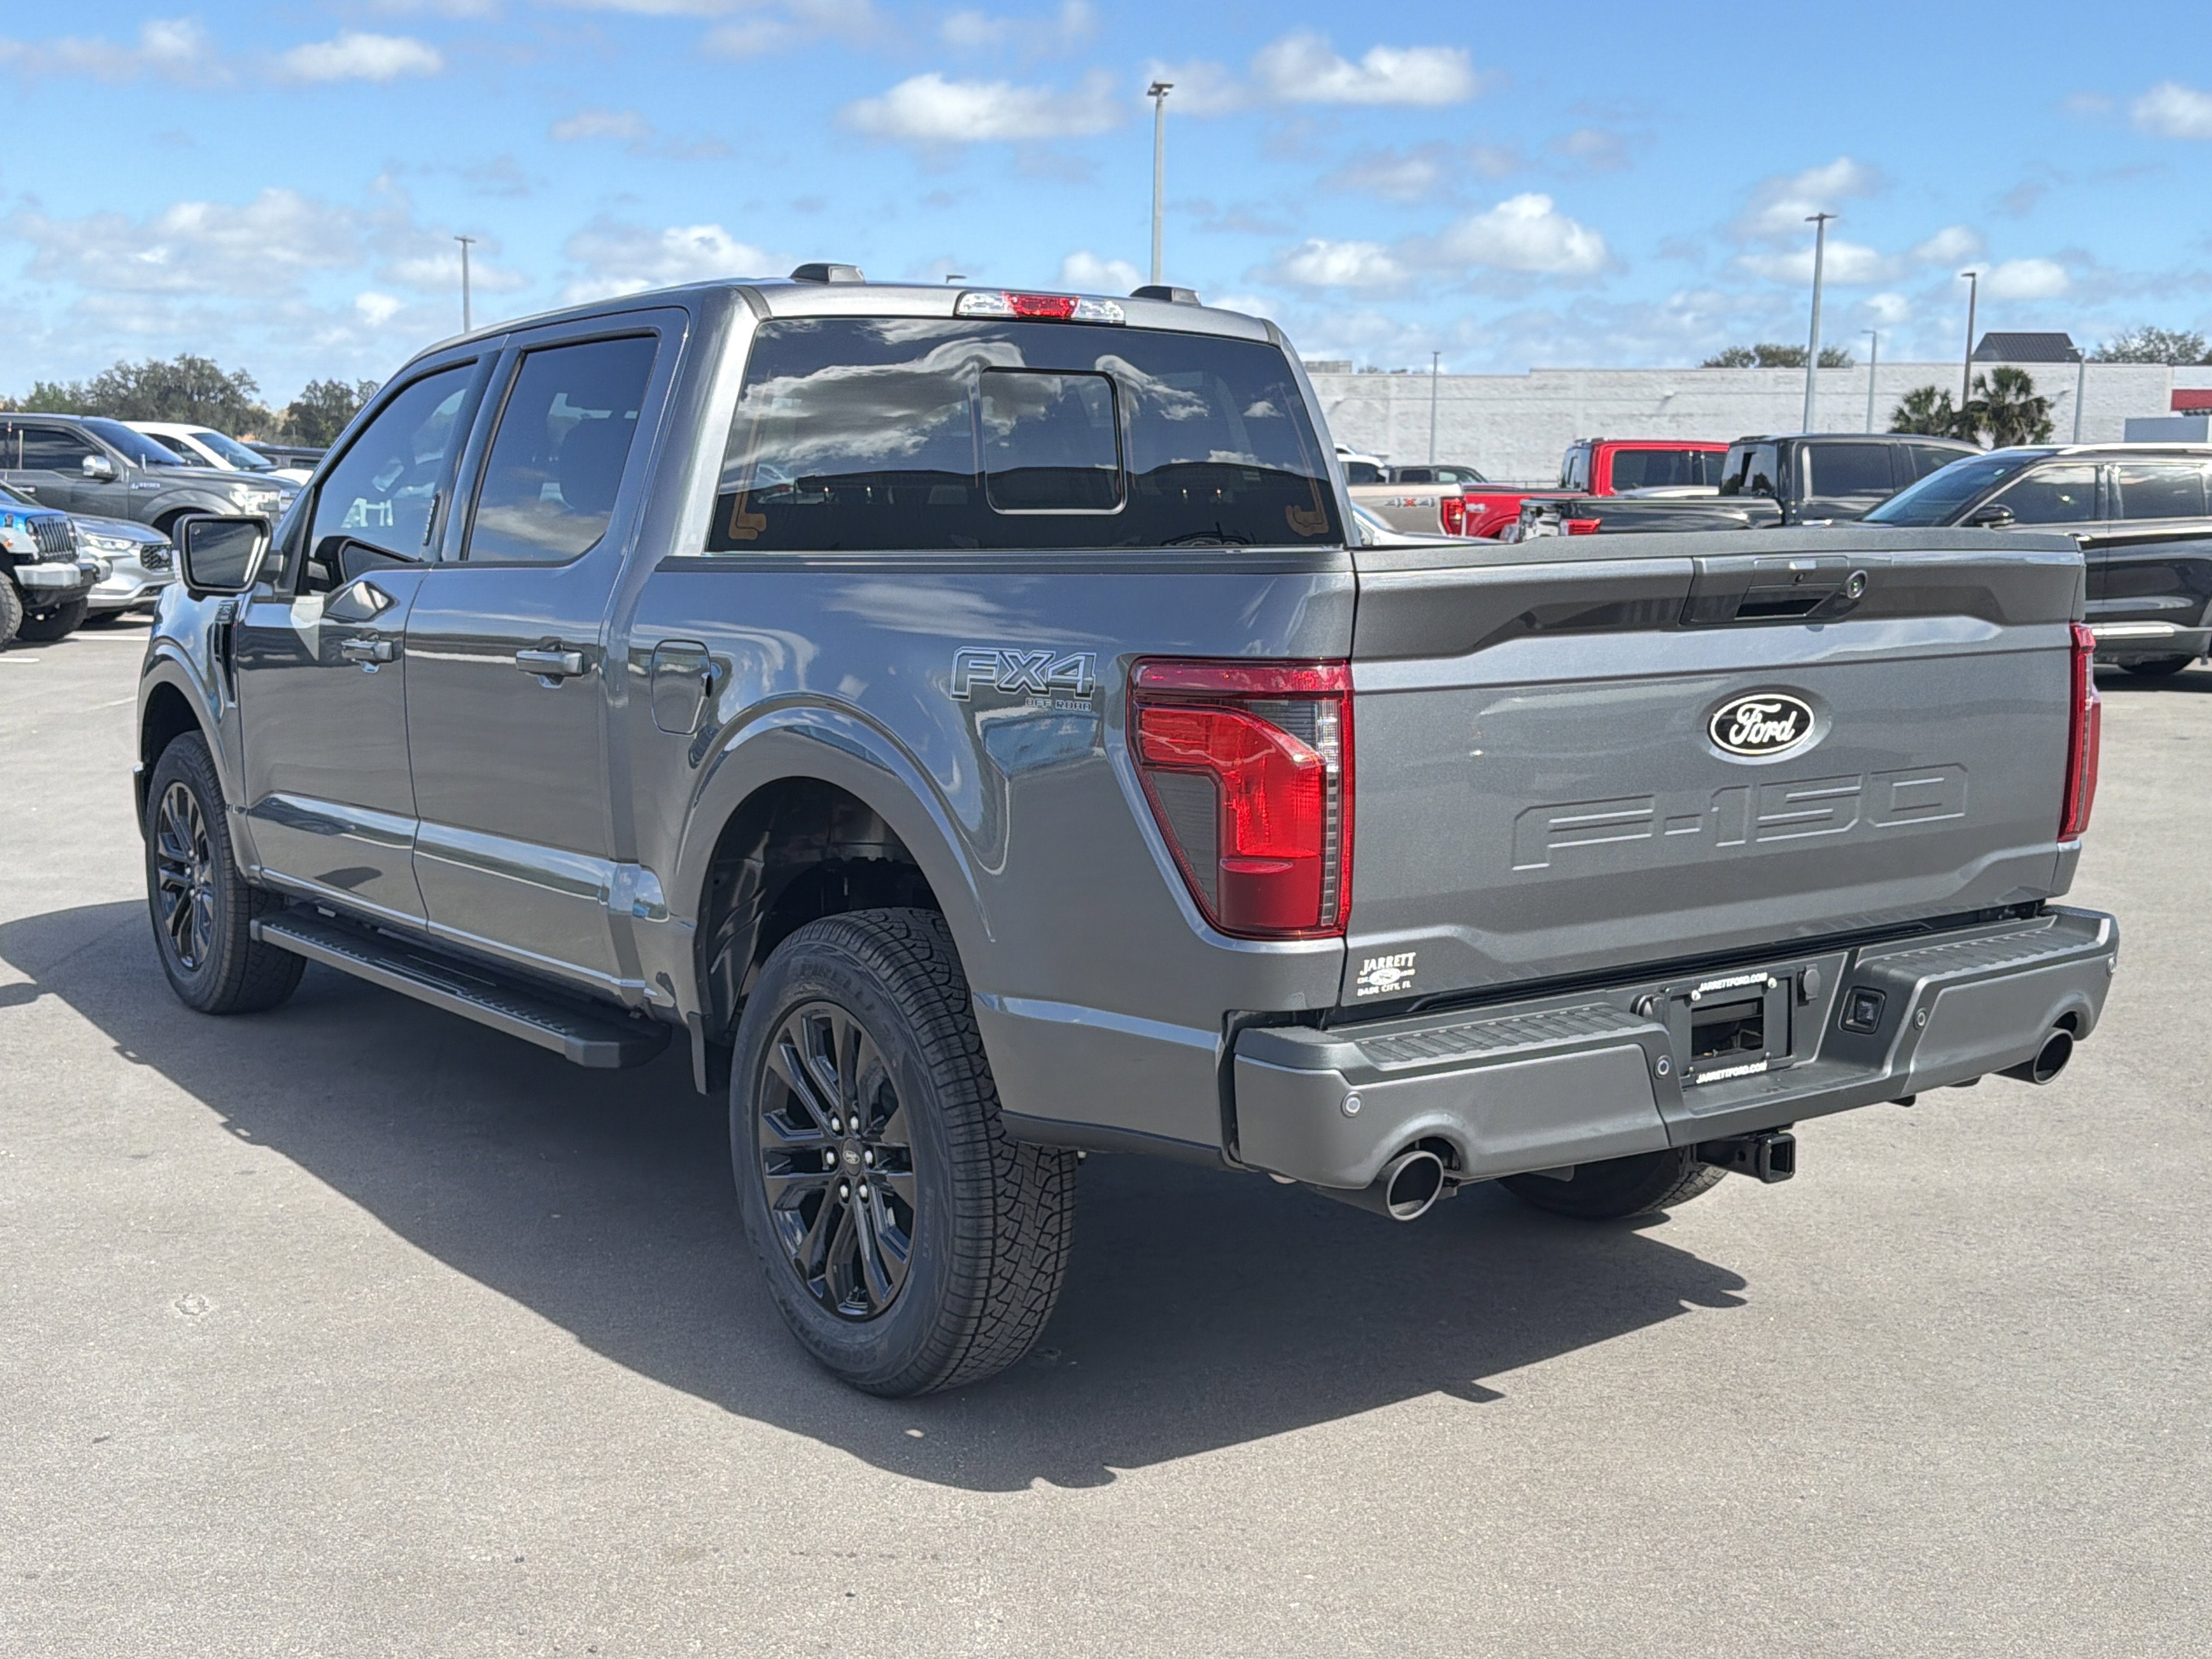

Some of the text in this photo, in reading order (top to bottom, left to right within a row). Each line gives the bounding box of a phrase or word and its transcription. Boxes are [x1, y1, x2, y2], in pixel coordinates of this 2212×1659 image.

[950, 646, 1096, 701] FX4
[1025, 697, 1092, 711] OFF ROAD
[1729, 703, 1797, 745] Ford
[1512, 763, 1970, 871] F-150
[1359, 952, 1417, 976] JARRETT
[1357, 986, 1379, 996] DADE
[1699, 972, 1768, 992] JARRETTFORD.COM
[1696, 1060, 1768, 1084] JARRETTFORD.COM
